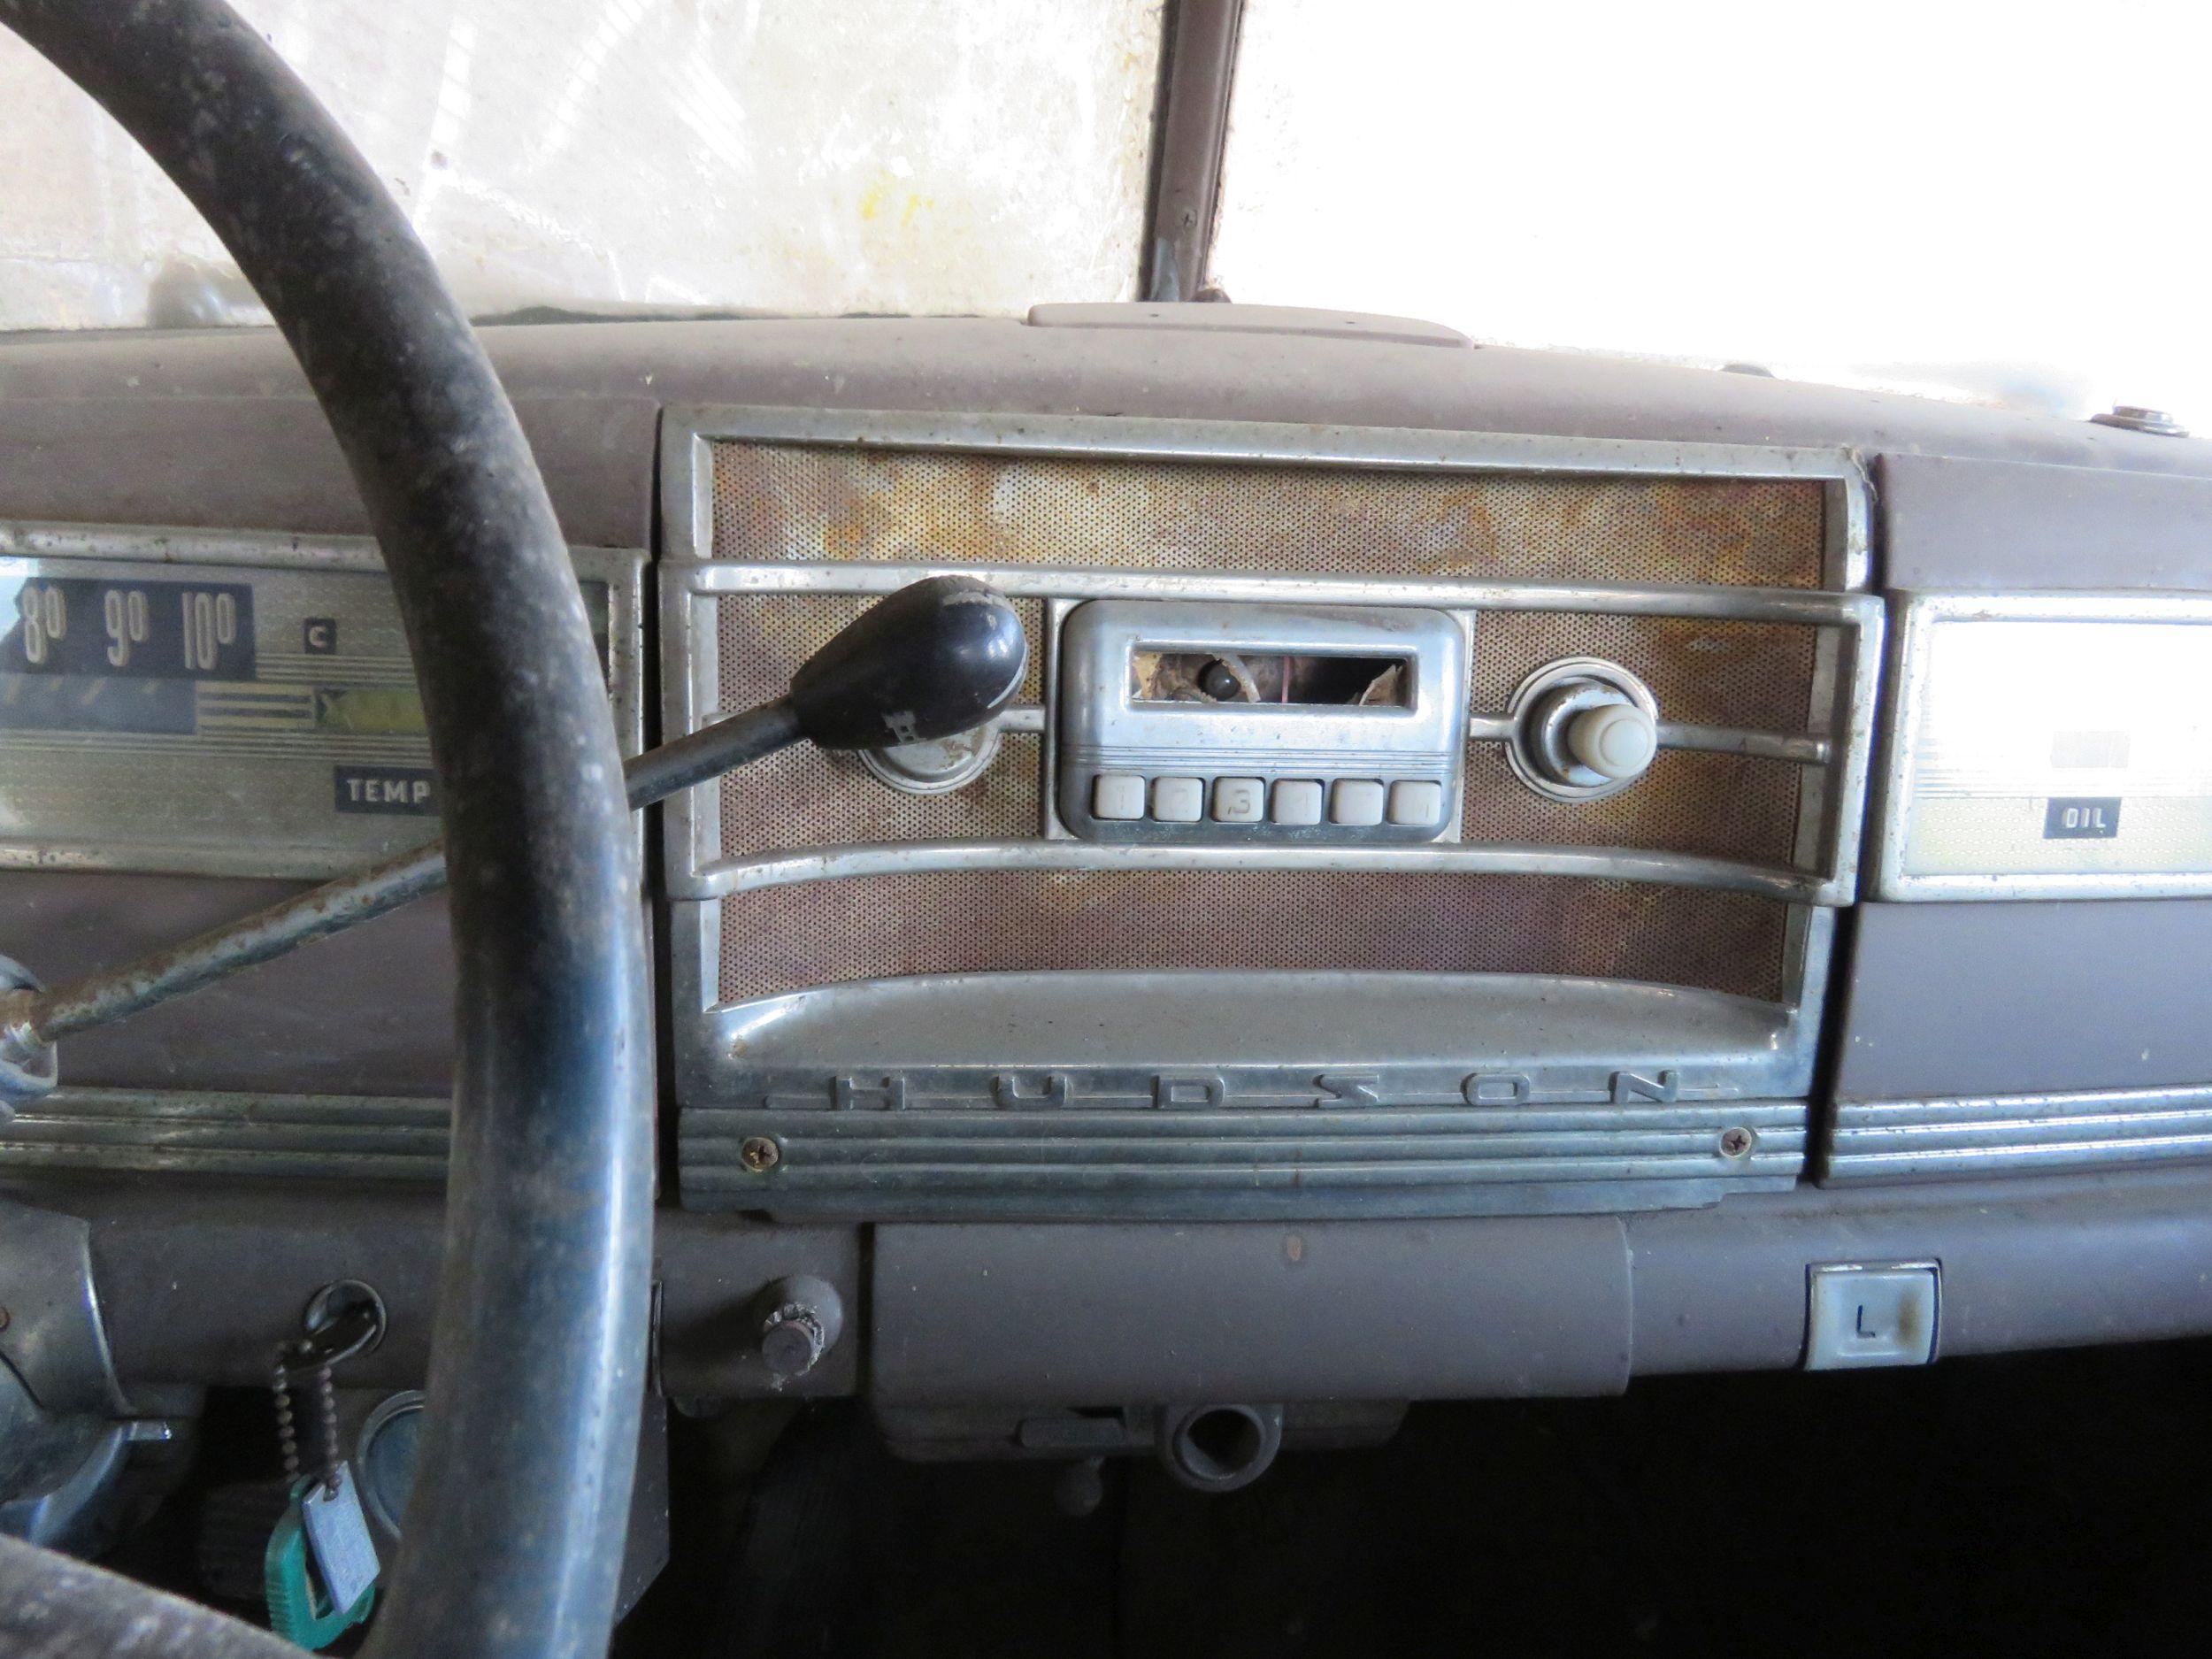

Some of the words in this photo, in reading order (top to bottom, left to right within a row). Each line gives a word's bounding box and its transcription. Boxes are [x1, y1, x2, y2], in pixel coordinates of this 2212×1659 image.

[22, 585, 67, 664] 80
[104, 588, 149, 667] 90
[181, 590, 236, 671] 100
[309, 625, 327, 649] C
[346, 777, 432, 804] TEMP
[1227, 788, 1251, 816] 3
[2063, 806, 2107, 829] OIL
[829, 1069, 1680, 1111] HUDSON
[1855, 1304, 1877, 1339] L
